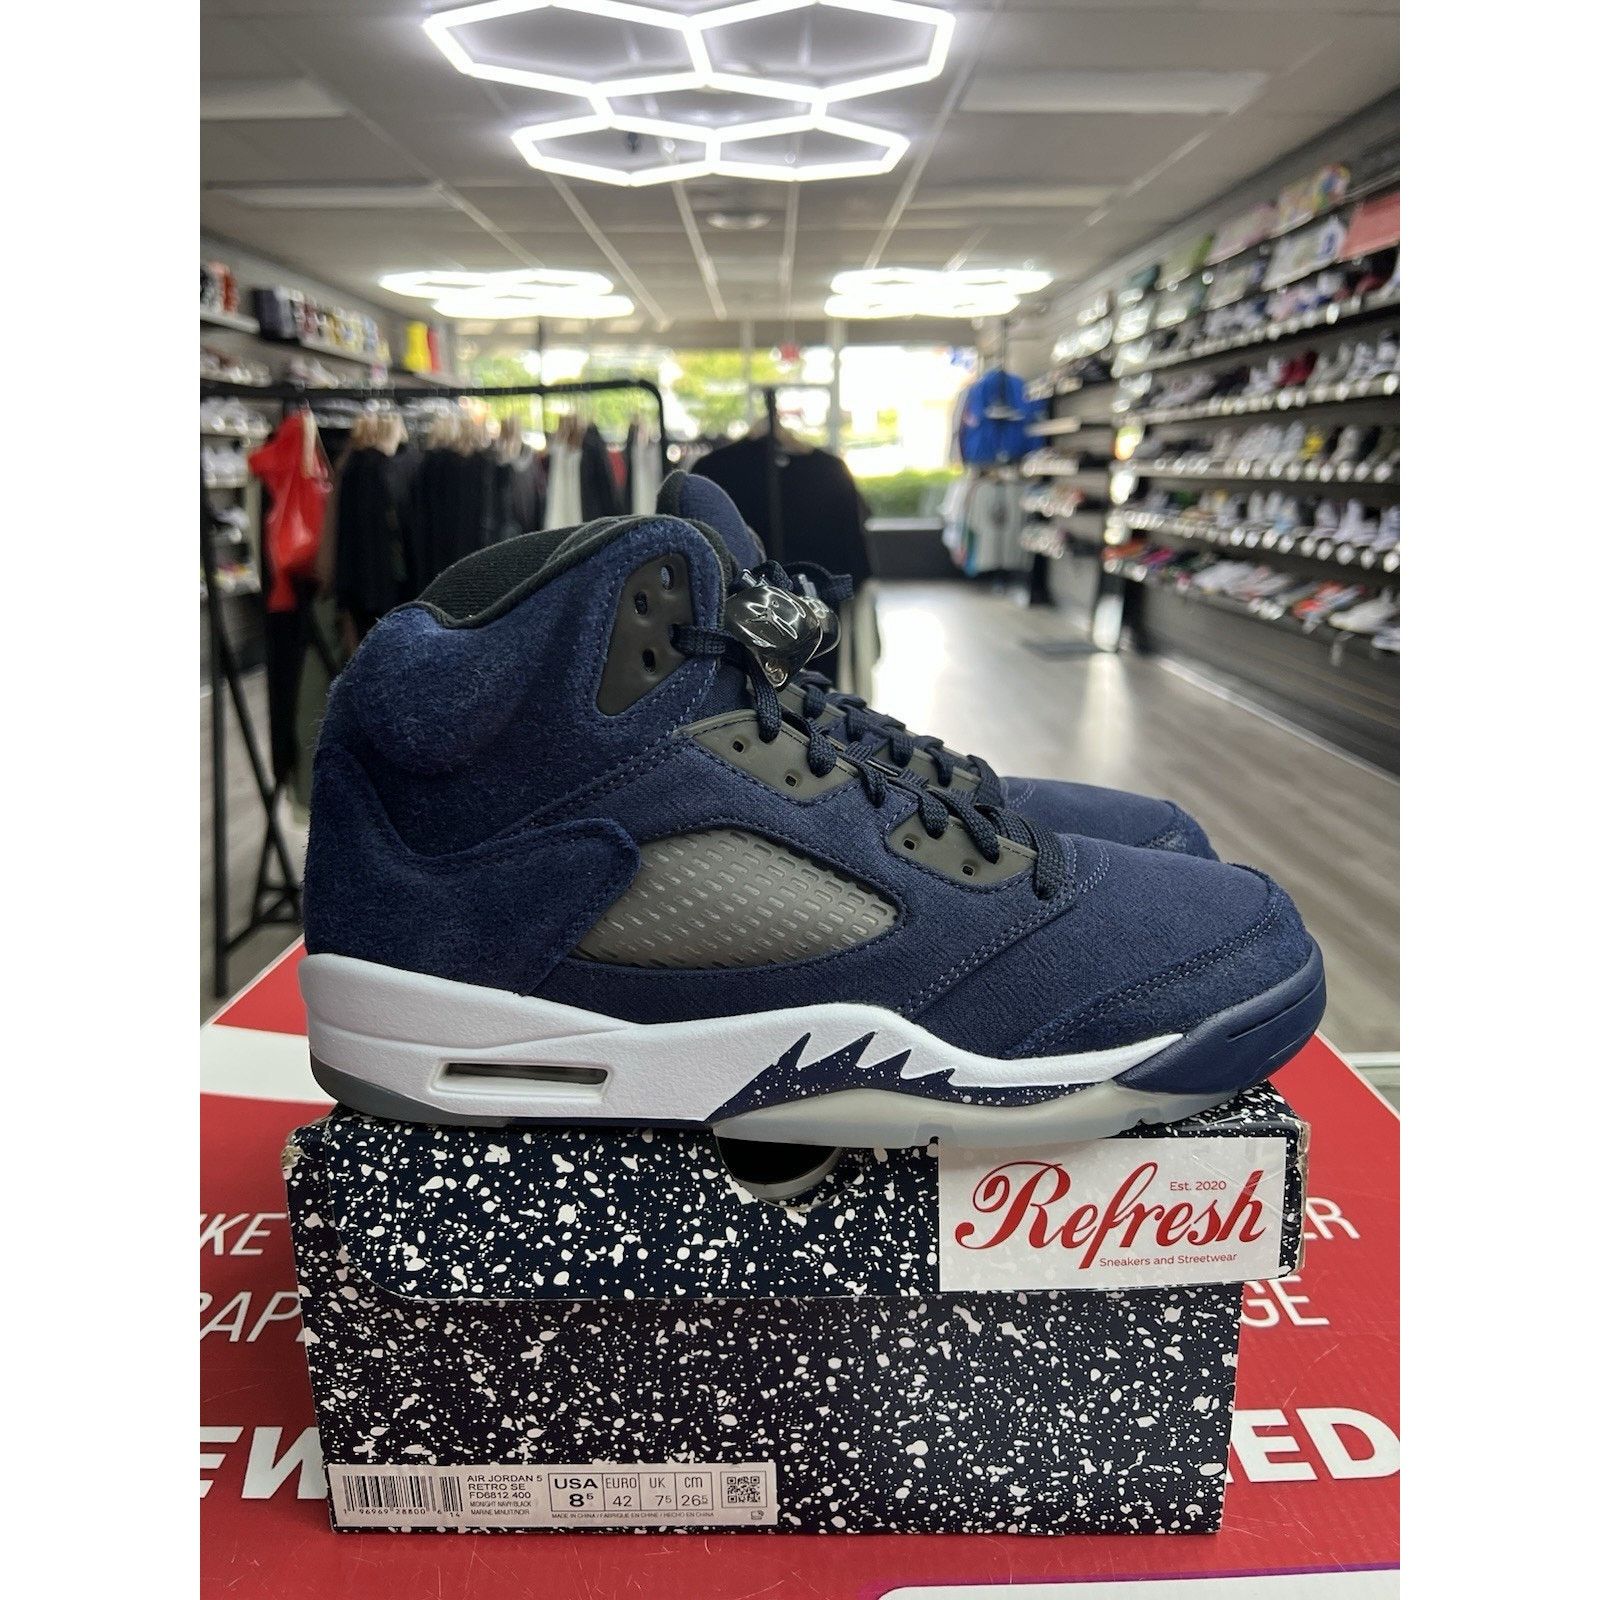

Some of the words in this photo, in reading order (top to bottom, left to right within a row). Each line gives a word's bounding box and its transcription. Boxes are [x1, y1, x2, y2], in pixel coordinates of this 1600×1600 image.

[1170, 1181, 1191, 1191] Est.
[1195, 1180, 1227, 1191] 2020
[954, 1160, 1269, 1269] Refresh
[200, 1213, 287, 1255] KE
[1099, 1257, 1151, 1267] Sneakers
[1153, 1255, 1175, 1265] and
[1177, 1252, 1238, 1265] Streetwear
[200, 1291, 304, 1342] AP
[1225, 1407, 1400, 1483] ED
[554, 1478, 598, 1489] USA
[605, 1477, 638, 1489] EURO
[649, 1477, 667, 1489] UK
[469, 1491, 509, 1499] FD6812
[511, 1491, 531, 1499] 400
[612, 1495, 632, 1507] 42
